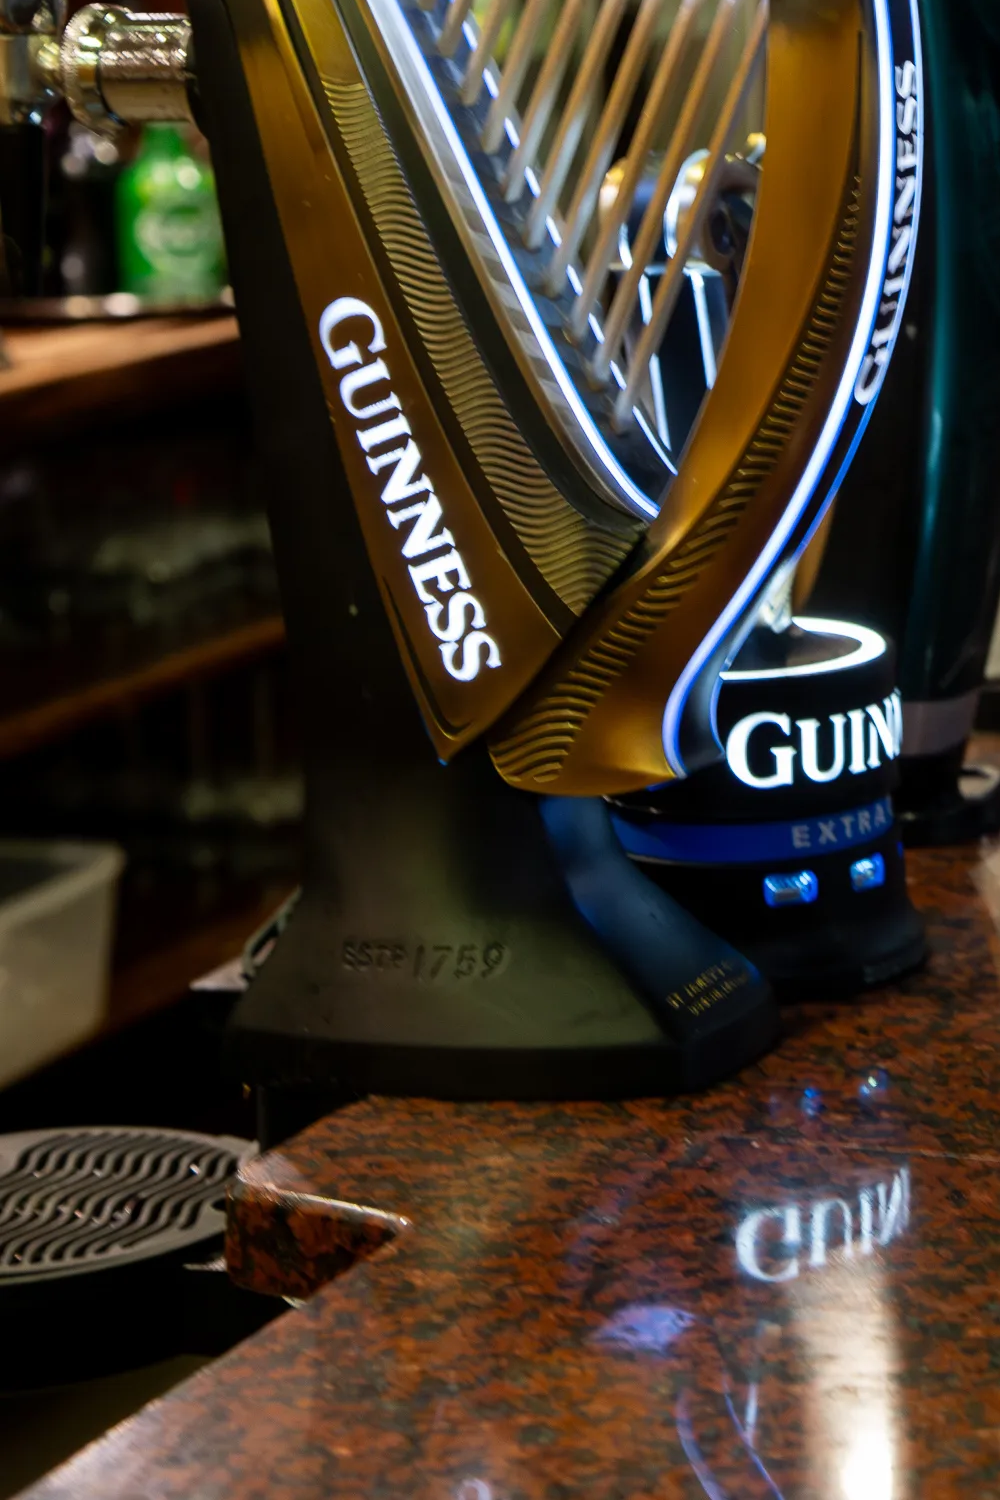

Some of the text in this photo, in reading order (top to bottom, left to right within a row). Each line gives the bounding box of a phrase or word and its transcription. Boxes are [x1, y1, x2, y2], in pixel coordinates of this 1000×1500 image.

[854, 59, 918, 406] GUINNESS
[318, 295, 502, 682] GUINNESS
[725, 687, 904, 790] GUIN
[412, 940, 505, 979] 1759
